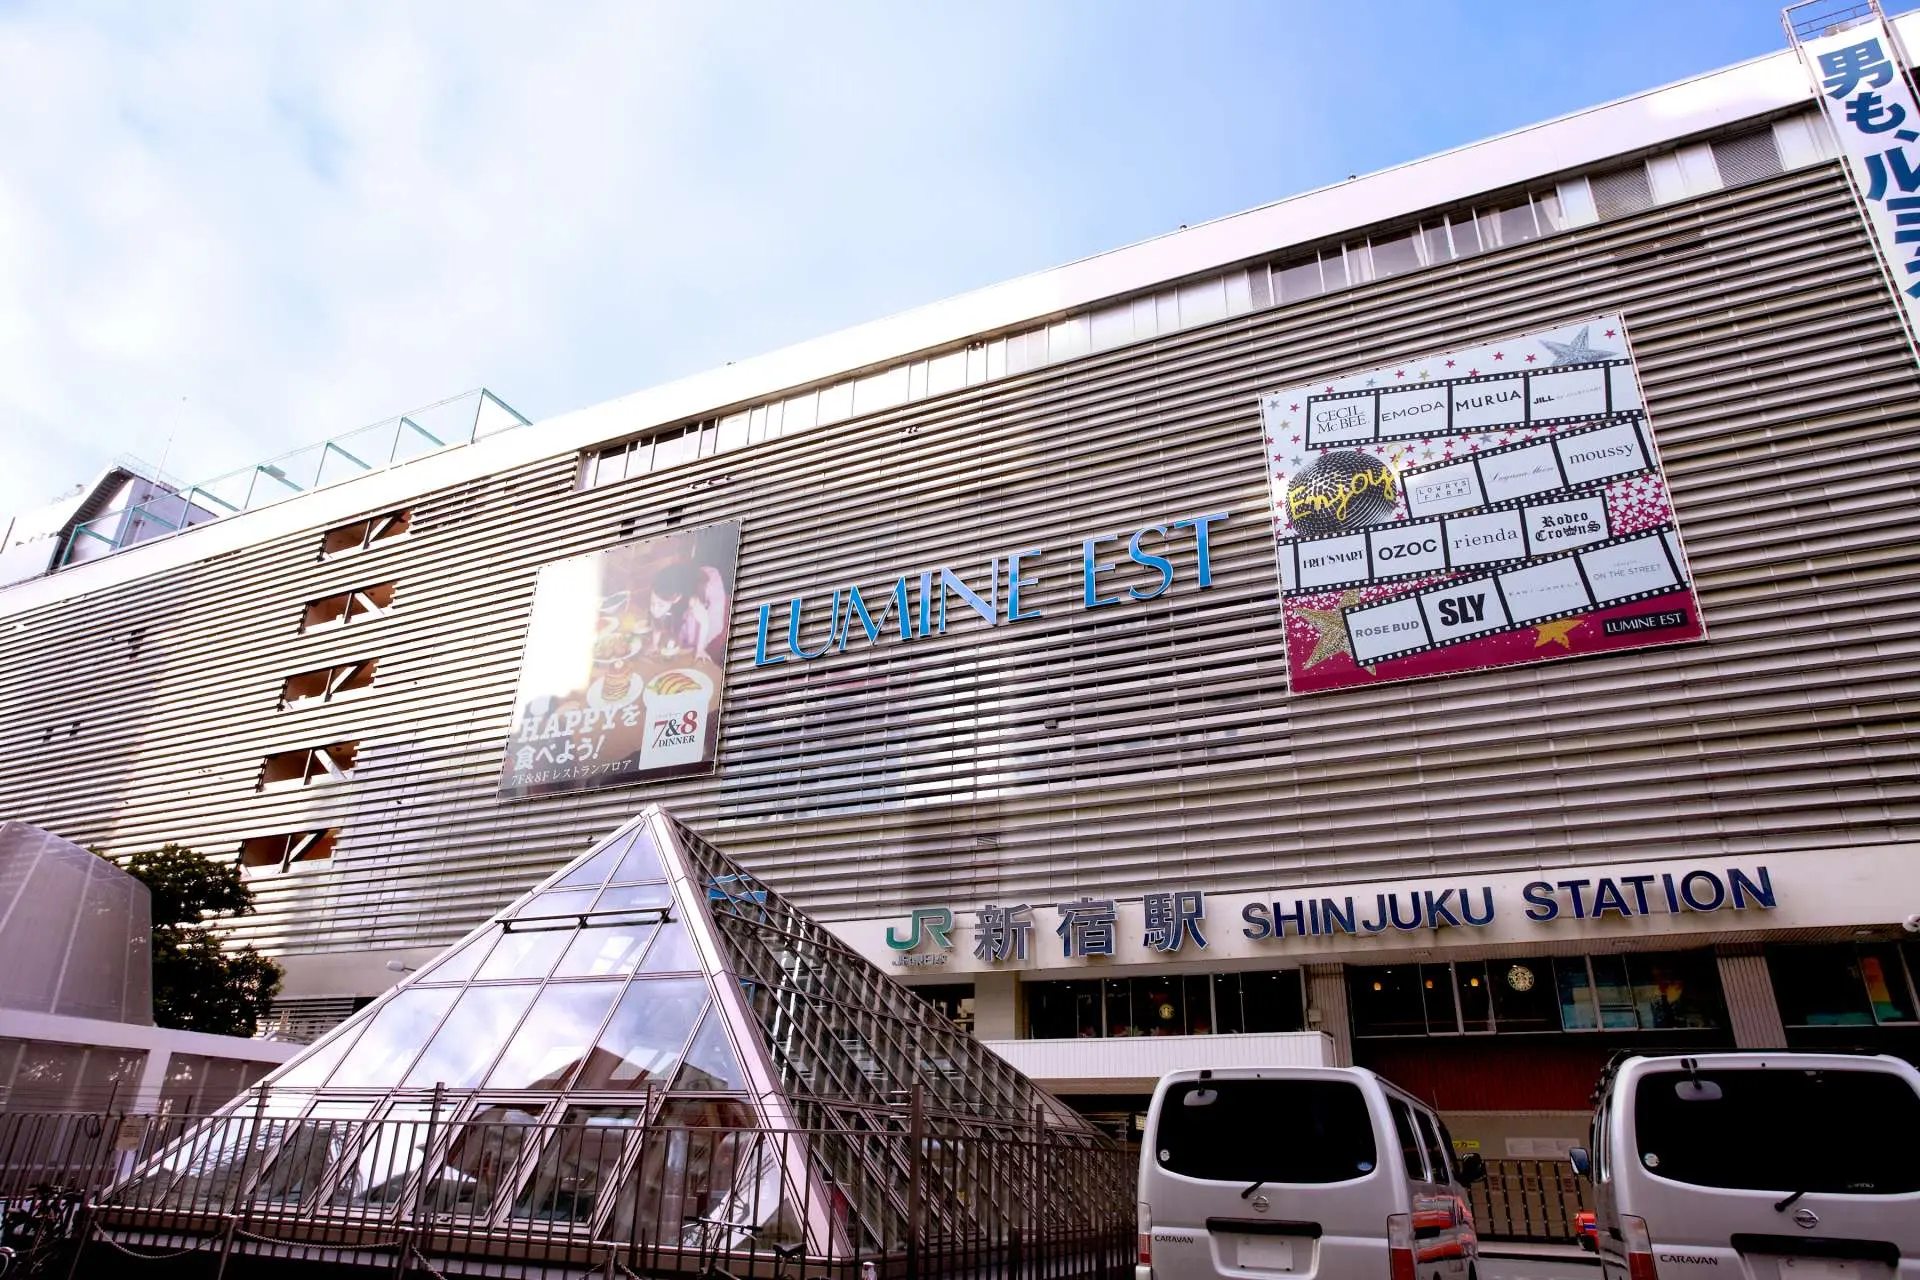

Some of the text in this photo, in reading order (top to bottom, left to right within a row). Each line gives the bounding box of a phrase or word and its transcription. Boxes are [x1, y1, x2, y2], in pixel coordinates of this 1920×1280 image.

[1455, 390, 1522, 412] MURUA
[1533, 395, 1555, 405] JILL
[1316, 405, 1361, 422] CECIL
[1381, 401, 1445, 422] EMODA
[1569, 443, 1635, 465] moussy
[1289, 466, 1396, 521] Enjoy
[1418, 480, 1468, 495] LOWRYS
[1424, 488, 1465, 501] FARM
[1541, 511, 1589, 528] Rodeo
[1454, 528, 1518, 549] rienda
[1378, 539, 1437, 560] OZOC
[1610, 568, 1626, 579] THE
[1629, 563, 1662, 576] STREET
[755, 512, 1229, 667] LUMINE EST
[1438, 593, 1485, 626] SLY
[1355, 620, 1420, 638] ROSE BUD
[1606, 612, 1683, 633] LUMINE EST
[651, 710, 698, 750] 7&8
[658, 735, 695, 748] DINNER
[973, 866, 1777, 962] 新宿駅 SHINJUKU STATION
[886, 908, 953, 951] JR
[1154, 1235, 1194, 1244] CARAVAN
[1660, 1254, 1719, 1266] CARAVAN
